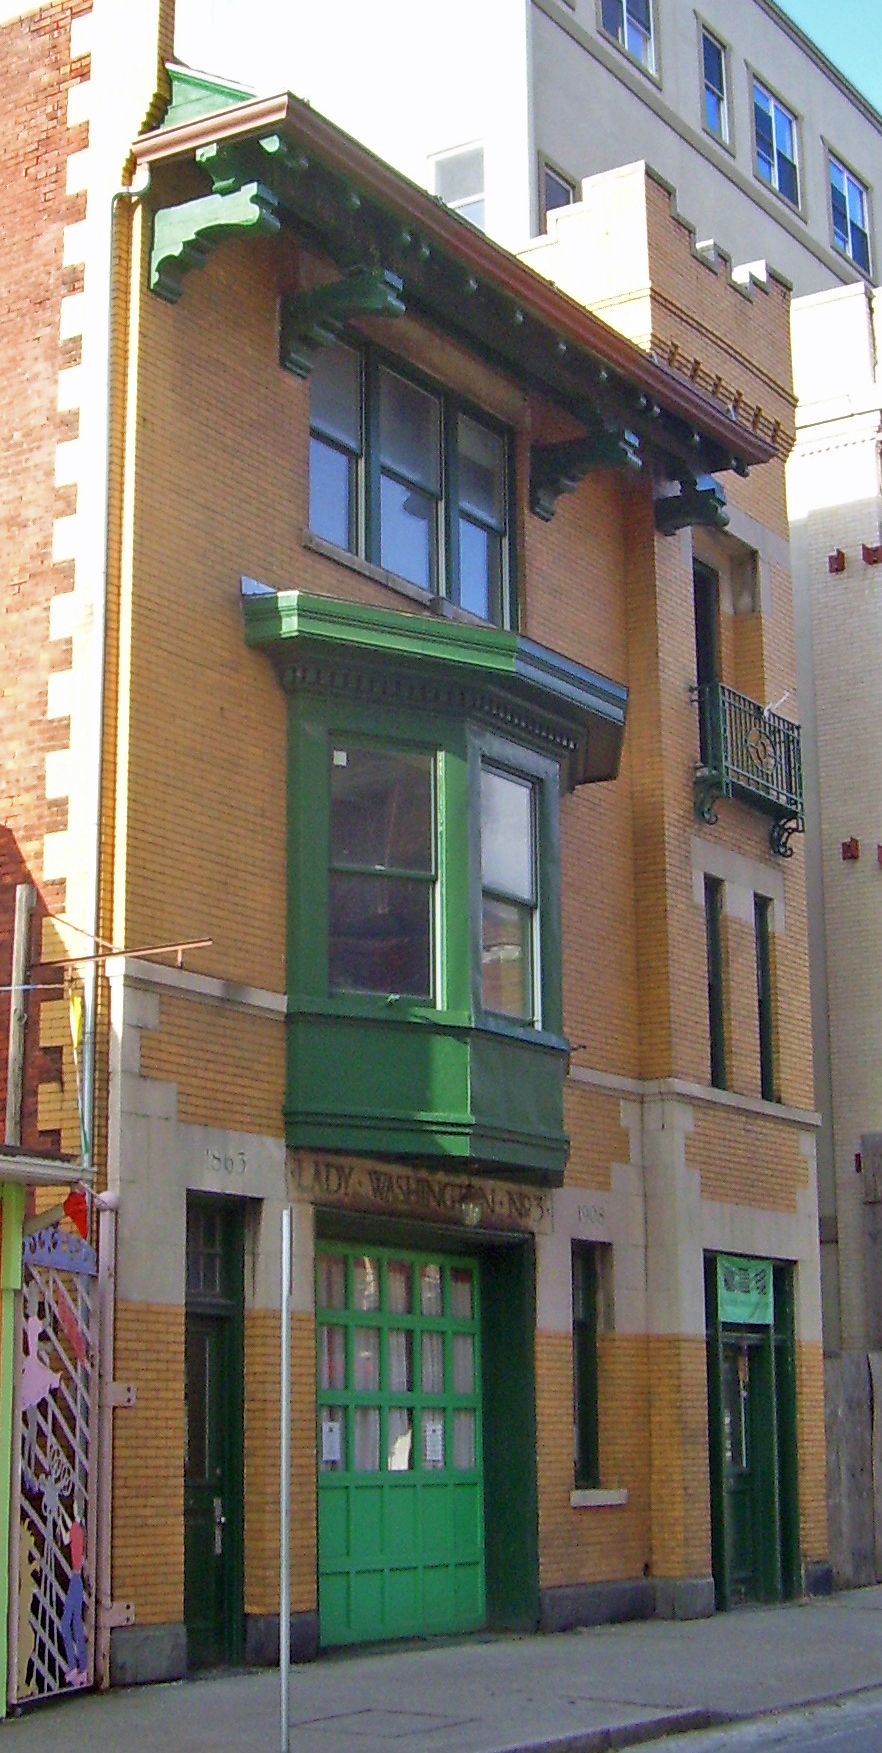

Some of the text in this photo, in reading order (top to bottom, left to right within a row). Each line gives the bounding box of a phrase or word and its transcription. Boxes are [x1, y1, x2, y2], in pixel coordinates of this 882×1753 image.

[206, 1147, 247, 1174] 1863
[297, 1158, 355, 1197] LADY
[367, 1171, 496, 1213] WASHINGTN
